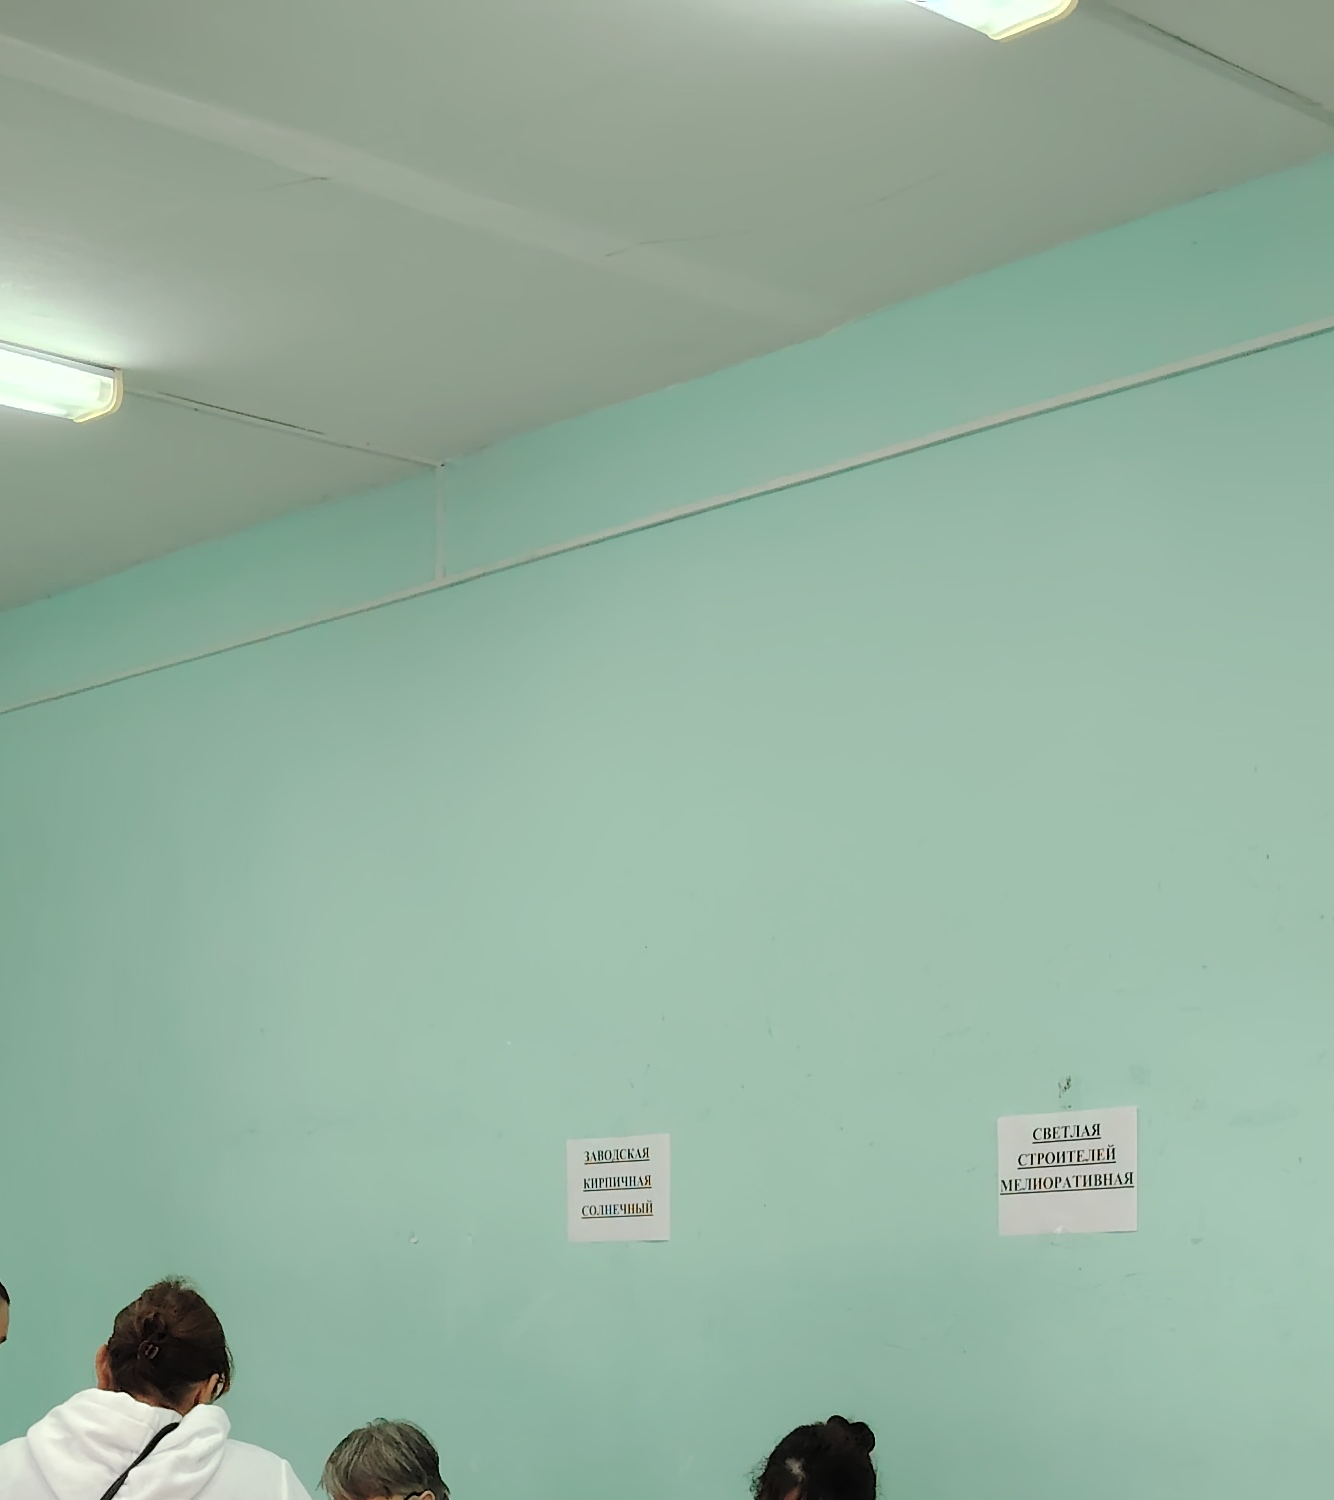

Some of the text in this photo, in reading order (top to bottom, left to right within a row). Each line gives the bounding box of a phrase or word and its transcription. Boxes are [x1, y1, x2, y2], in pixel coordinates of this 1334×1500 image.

[1032, 1123, 1101, 1141] СВЕТЛАЯ
[583, 1147, 650, 1162] ЗАВОДСКАЯ
[1017, 1144, 1116, 1167] СТРОИТЕЛЕЙ
[583, 1175, 652, 1190] КИРПИЧНАЯ
[1000, 1172, 1135, 1192] МЕЛИОРАТИВНАЯ
[581, 1200, 654, 1217] СОЛНЕЧНЫЙ
